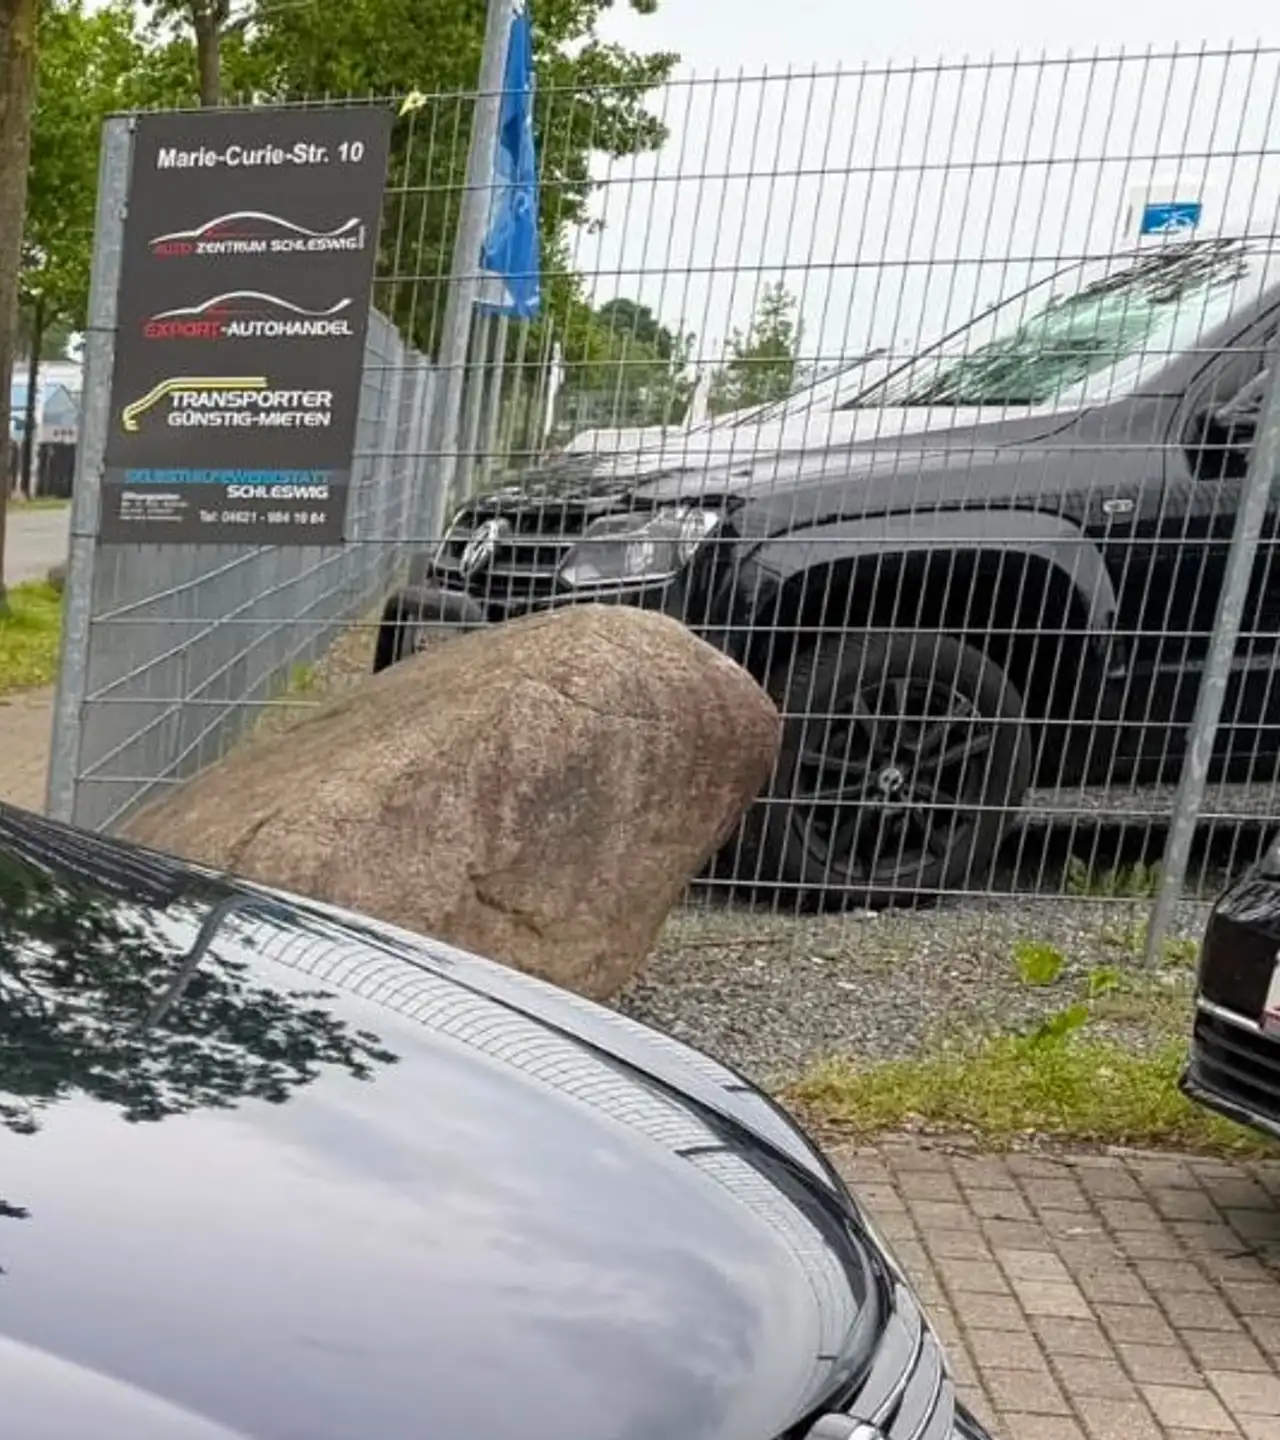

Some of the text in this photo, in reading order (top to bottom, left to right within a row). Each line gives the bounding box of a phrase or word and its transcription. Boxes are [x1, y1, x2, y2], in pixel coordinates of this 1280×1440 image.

[157, 141, 364, 169] Marie-Curie-Str. 10
[195, 239, 267, 254] ZENTRUM
[269, 236, 358, 252] SCHLESWIG
[170, 390, 333, 408] TRANSPORTER
[167, 410, 331, 427] GÜNSTIG-MIETEN
[226, 485, 329, 499] SCHLESWIG
